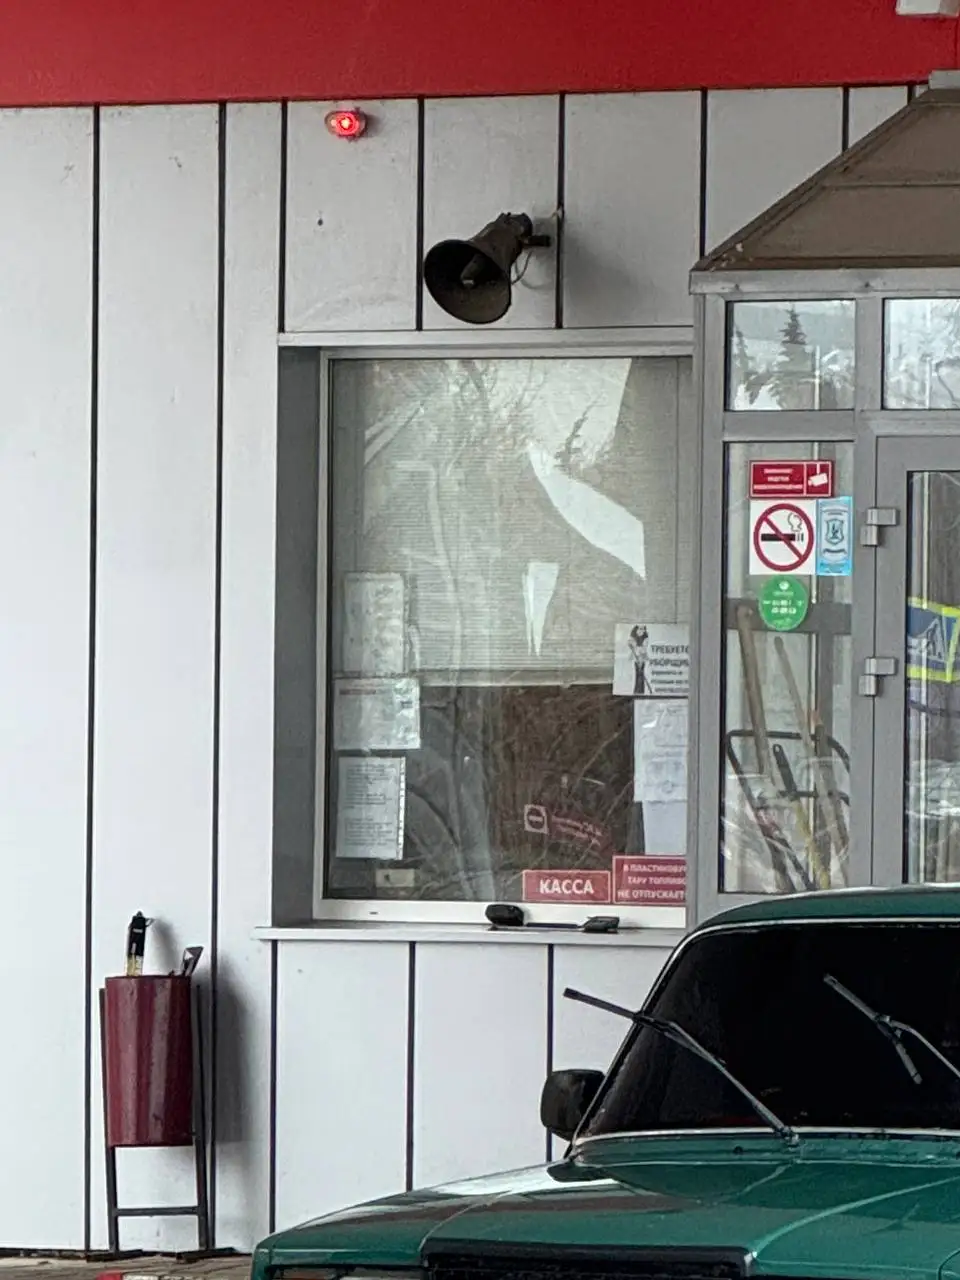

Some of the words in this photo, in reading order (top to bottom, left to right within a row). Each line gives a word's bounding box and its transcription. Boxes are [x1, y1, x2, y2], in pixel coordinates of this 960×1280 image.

[650, 644, 689, 654] ТРЕБУЕТС
[630, 863, 687, 873] ПЛАСТИКОВУ
[627, 876, 647, 885] ТАРУ
[539, 878, 595, 895] КАССА
[617, 889, 631, 899] НЕ
[632, 889, 685, 900] ОТПУСКАЕТ
